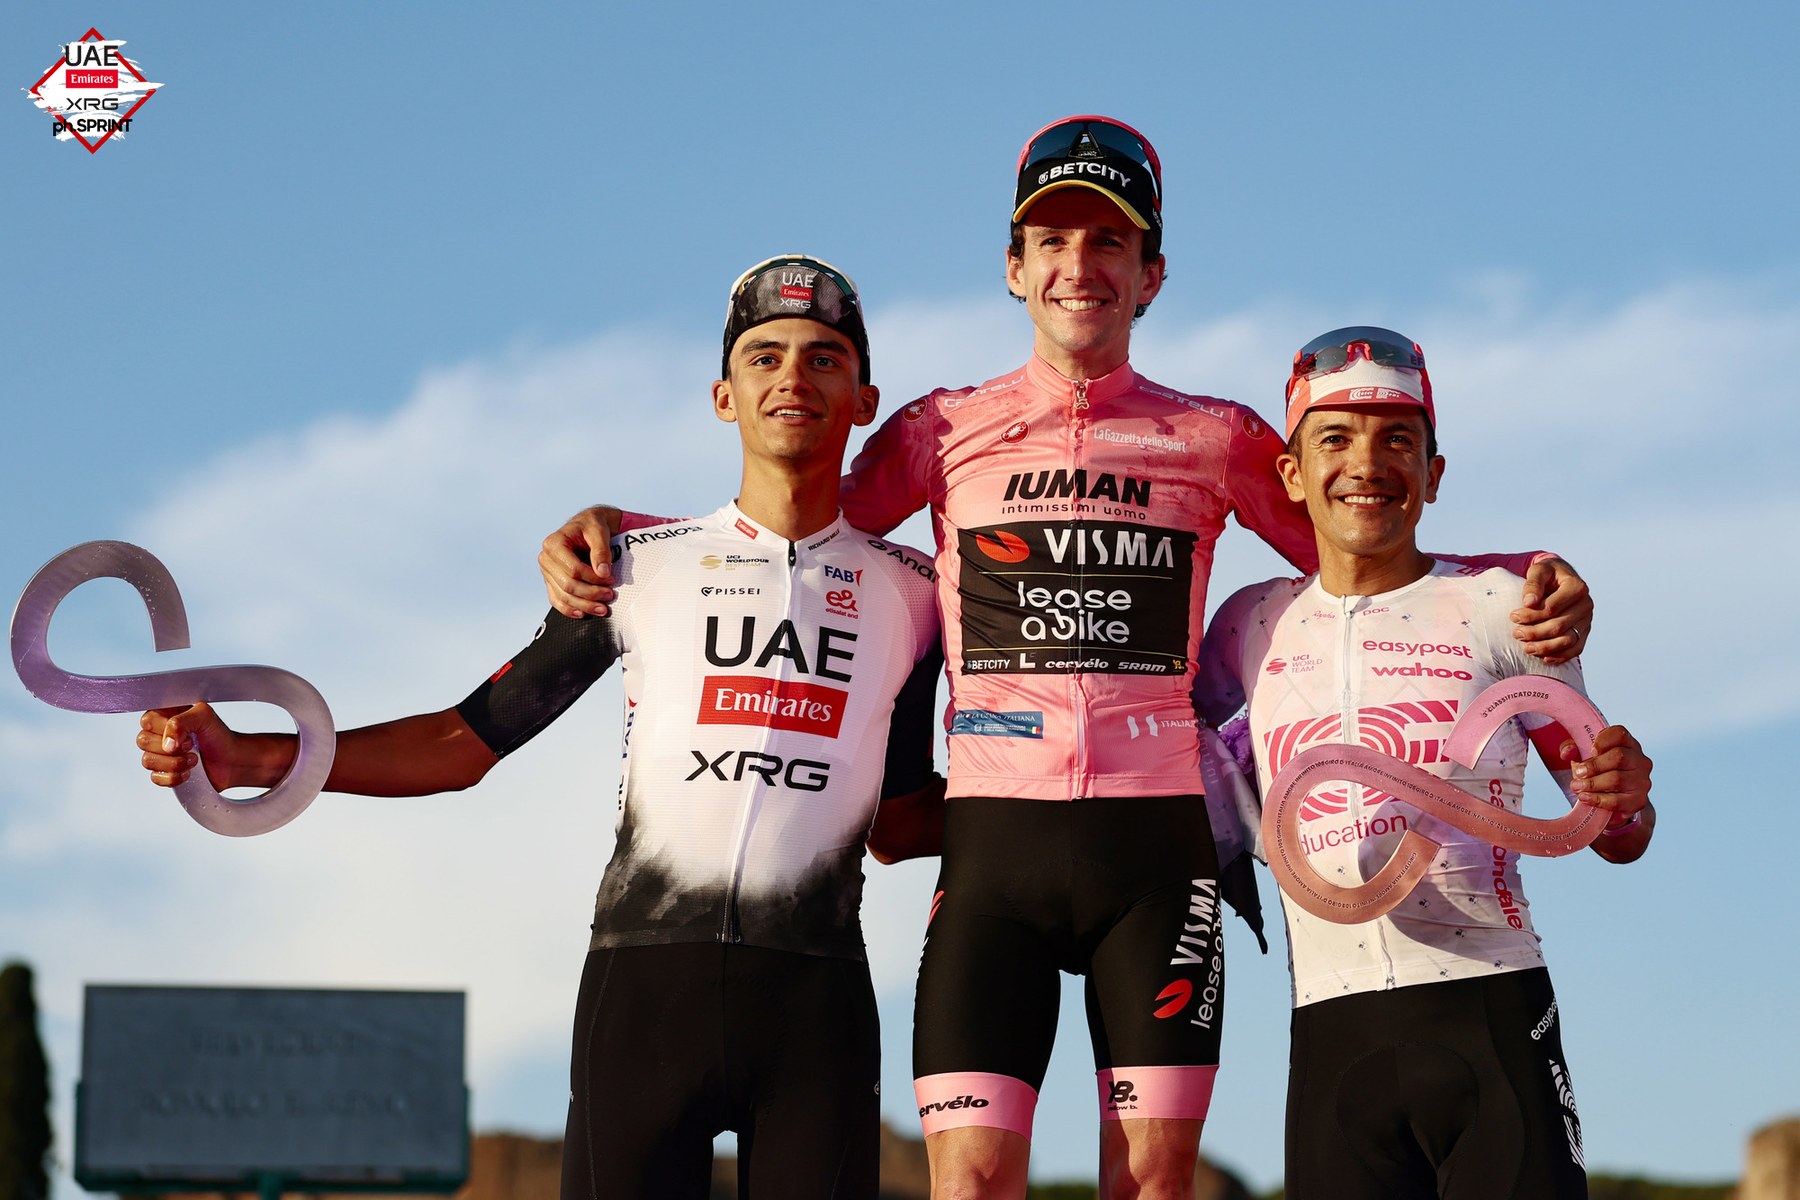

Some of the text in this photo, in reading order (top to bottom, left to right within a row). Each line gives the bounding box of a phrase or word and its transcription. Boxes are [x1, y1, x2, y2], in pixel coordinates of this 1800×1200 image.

[1050, 162, 1131, 188] BETCITY
[783, 272, 814, 288] UAE
[780, 298, 811, 309] XRG
[1093, 427, 1103, 440] La
[1104, 428, 1141, 444] Gazzetta
[1140, 435, 1163, 447] dello
[1163, 438, 1186, 453] Sport
[1003, 469, 1152, 507] IUMAN
[1002, 502, 1146, 520] intimissimi uomo
[1043, 528, 1174, 568] VISMA
[1018, 581, 1132, 611] lease
[705, 616, 858, 683] UAE
[1363, 640, 1473, 659] easypost
[971, 660, 1010, 669] BETCITY
[1044, 658, 1109, 669] cervélo
[1117, 661, 1166, 672] SRAM
[1291, 658, 1323, 667] WORLD
[1291, 665, 1314, 673] TEAM
[1371, 662, 1473, 681] wahoo
[715, 688, 832, 722] Emirates
[684, 751, 831, 792] XRG
[1301, 815, 1408, 855] ducation
[1170, 879, 1216, 965] VISMA
[1190, 955, 1222, 1029] lease
[918, 1095, 989, 1118] ervélo
